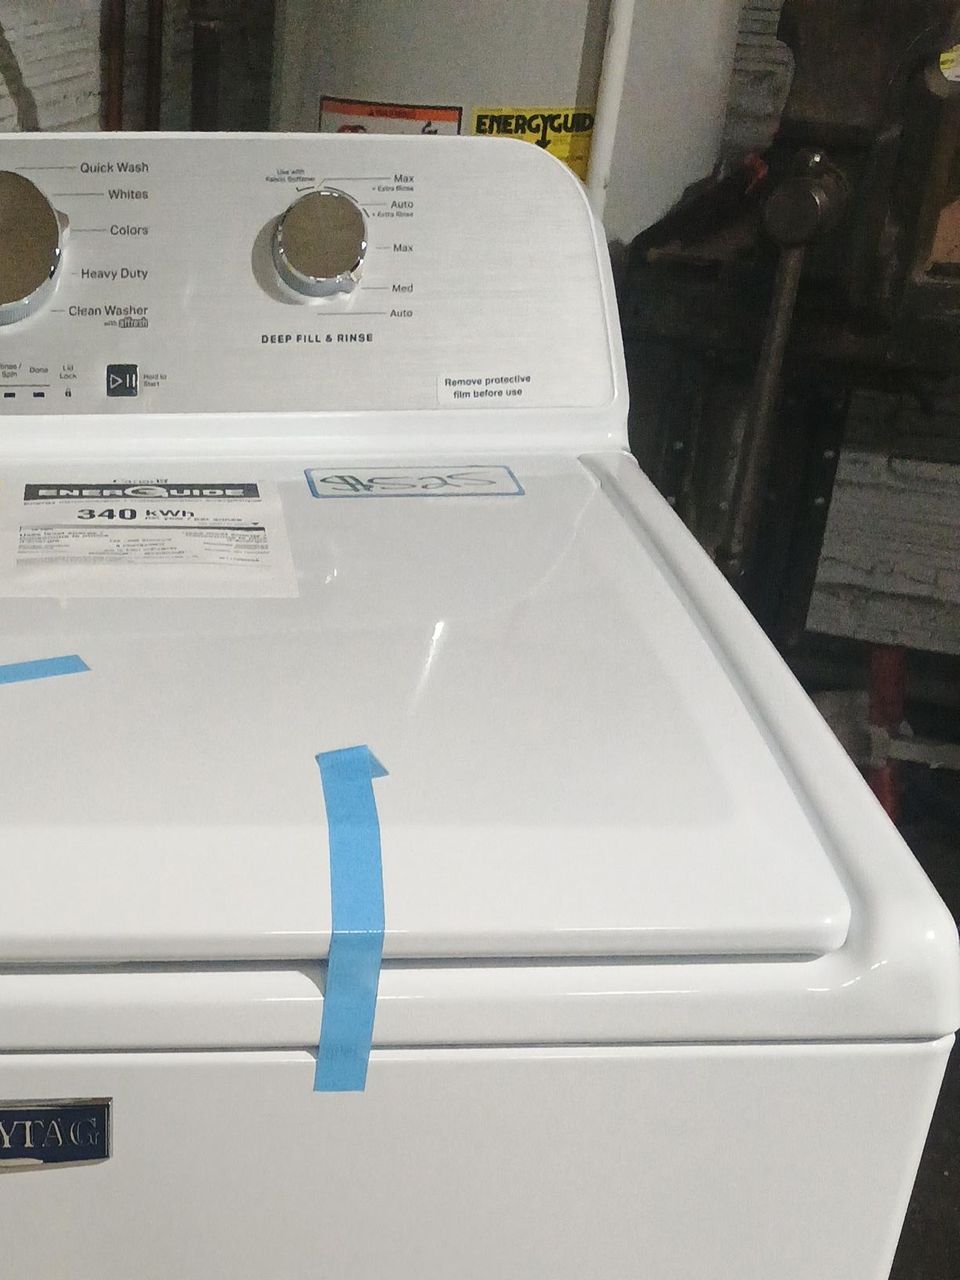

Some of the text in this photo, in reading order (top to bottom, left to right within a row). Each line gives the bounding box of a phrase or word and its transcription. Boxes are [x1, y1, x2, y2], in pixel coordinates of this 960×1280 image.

[476, 114, 591, 135] ENERGYGUID
[80, 162, 149, 173] Quick Wash
[394, 174, 414, 183] Max
[108, 189, 148, 200] Whites
[391, 201, 414, 209] Auto
[110, 225, 148, 235] Colors
[393, 244, 413, 252] Max
[81, 268, 148, 280] Heavy Duty
[392, 284, 413, 293] Med
[68, 305, 148, 316] Clean Washer
[261, 333, 373, 344] DEEP FILL & RINSE
[445, 375, 531, 386] Remove protective
[453, 390, 470, 399] film
[473, 389, 503, 398] before
[77, 508, 195, 520] 340 kWh
